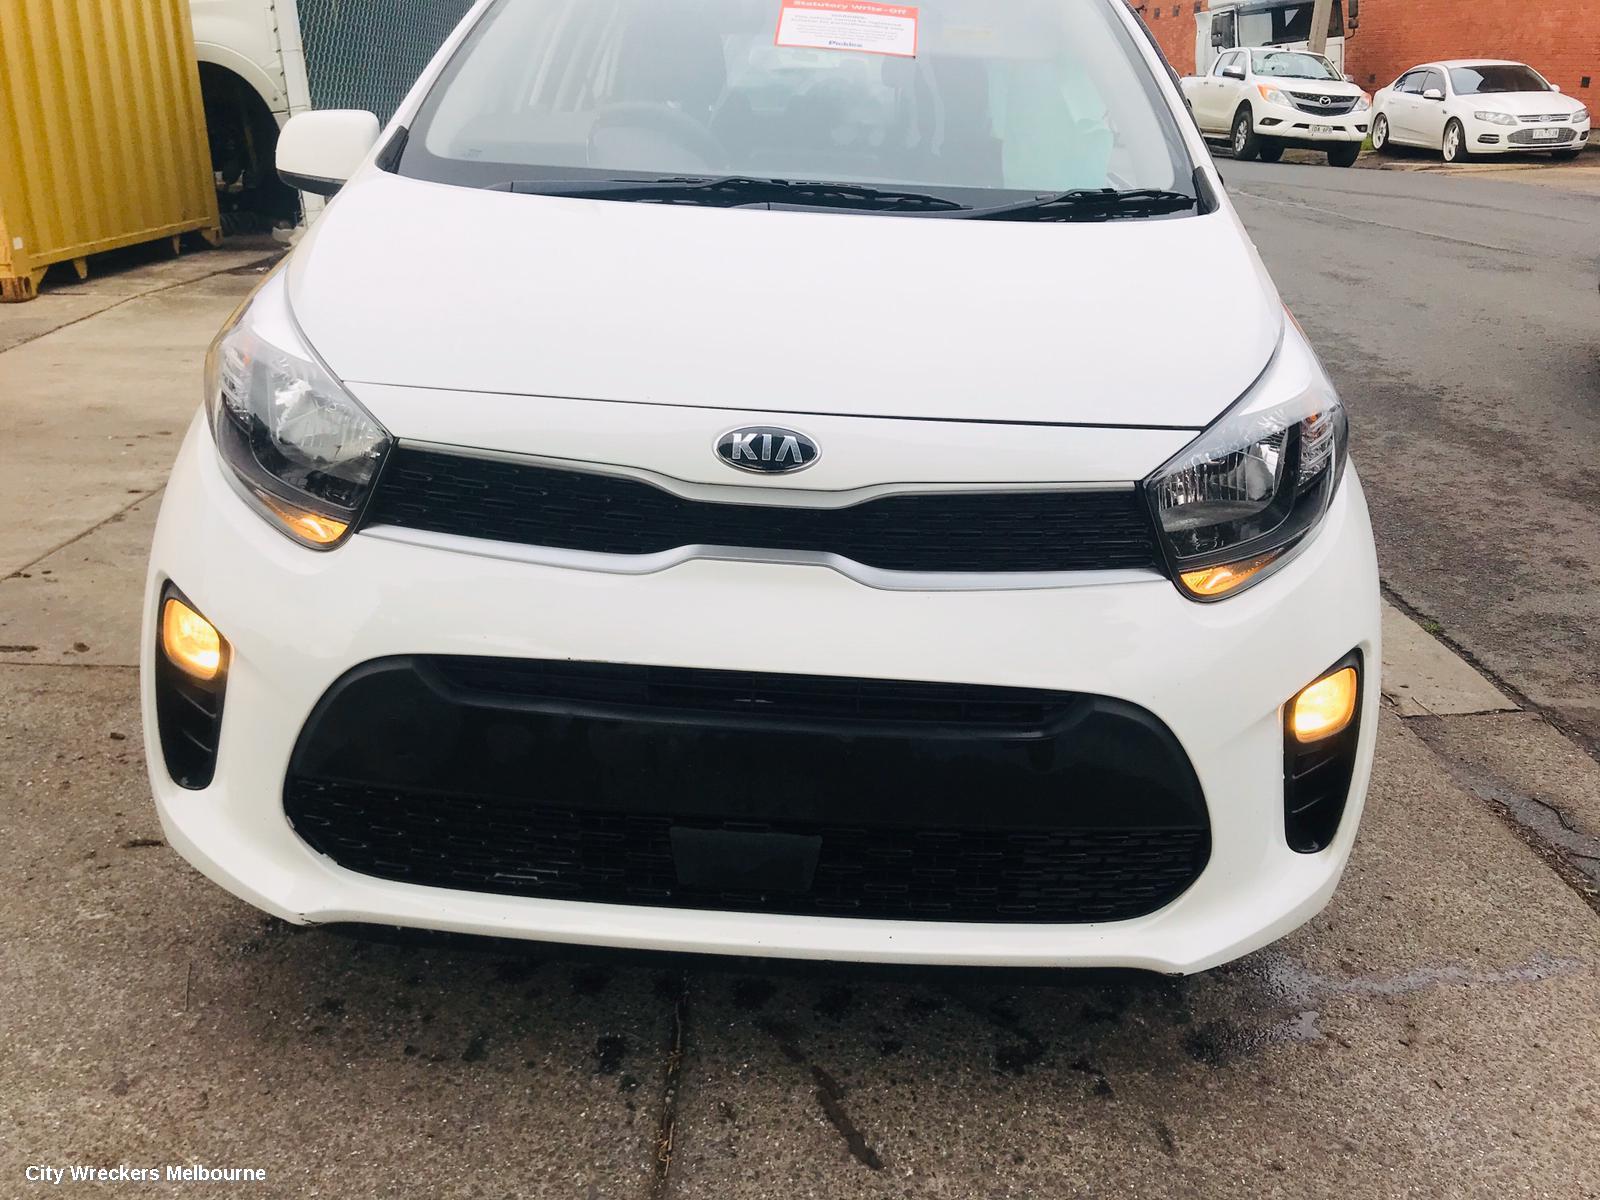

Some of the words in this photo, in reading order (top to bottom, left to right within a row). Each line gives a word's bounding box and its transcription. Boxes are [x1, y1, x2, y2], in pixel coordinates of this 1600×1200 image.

[793, 0, 848, 10] Statutory
[851, 4, 907, 15] Write-Off
[731, 433, 803, 463] KIA
